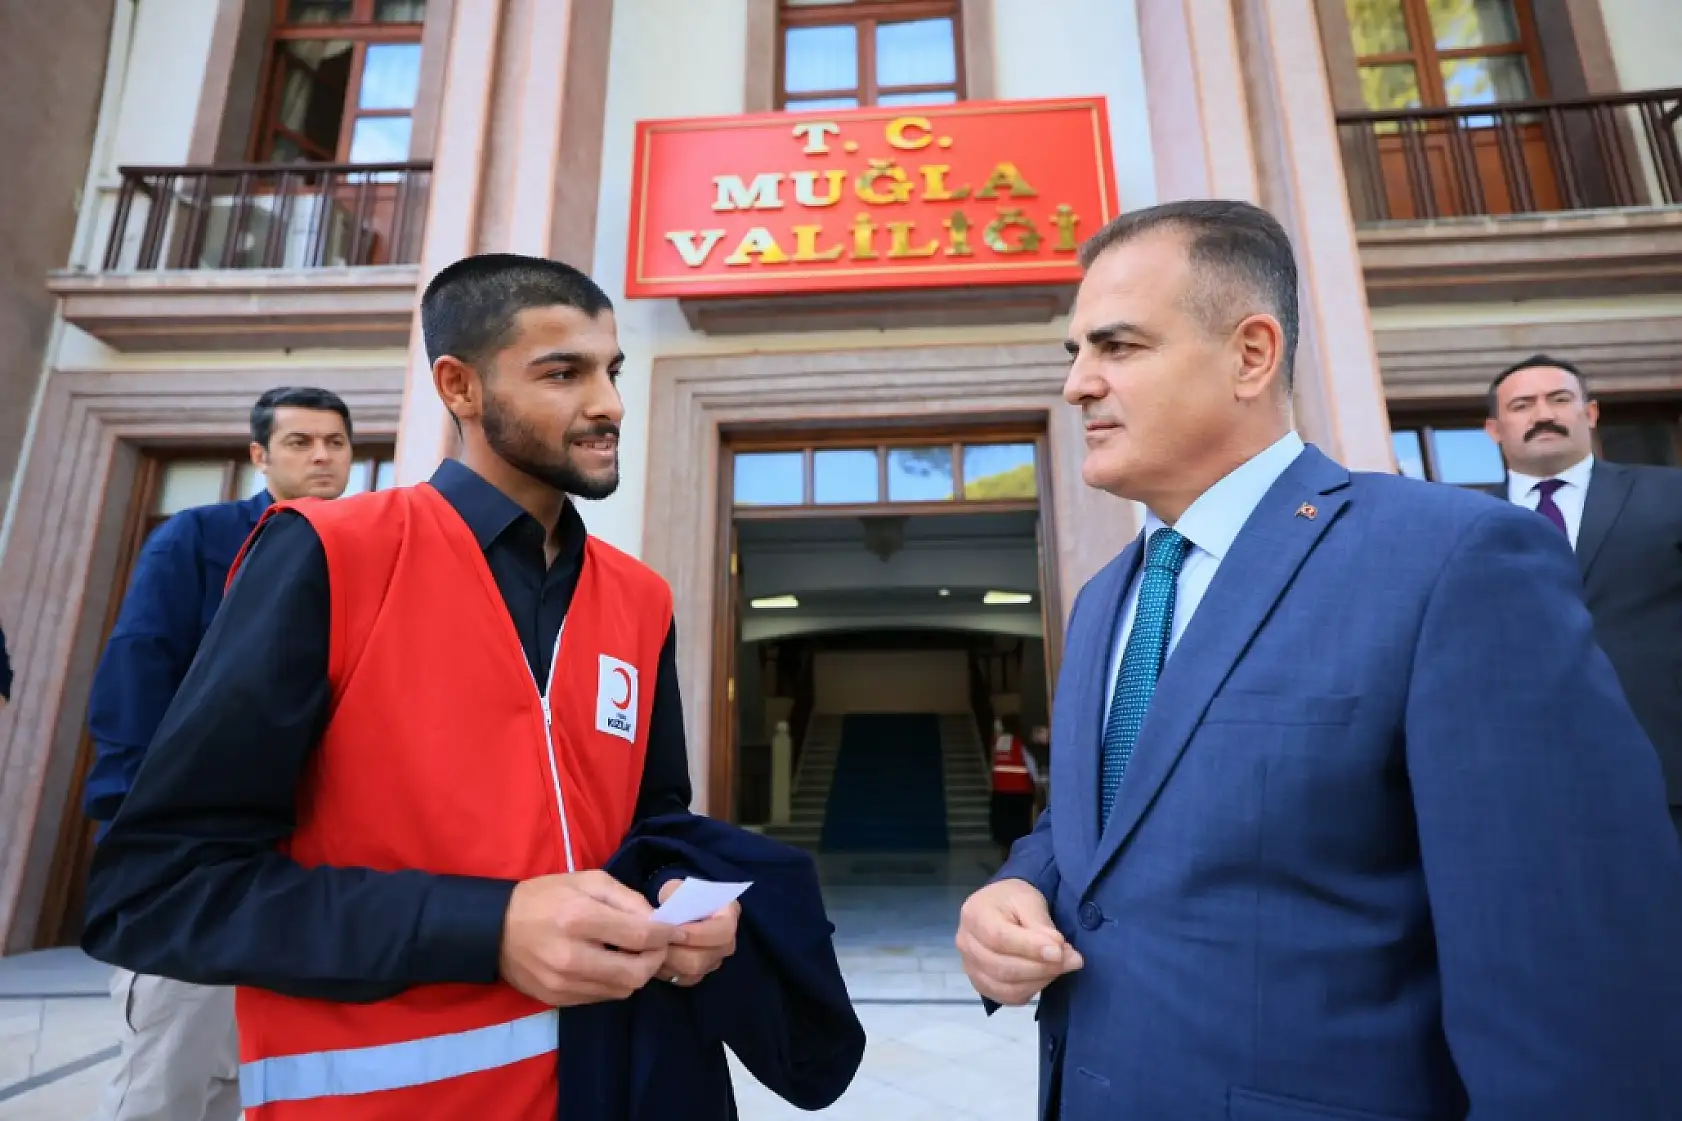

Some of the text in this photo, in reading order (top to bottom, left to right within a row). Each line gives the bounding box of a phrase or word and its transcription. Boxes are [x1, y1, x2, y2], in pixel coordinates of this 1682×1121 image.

[792, 116, 953, 155] T. C.
[711, 158, 1038, 211] MUĞLA
[664, 203, 1081, 267] VALİLİĞİ
